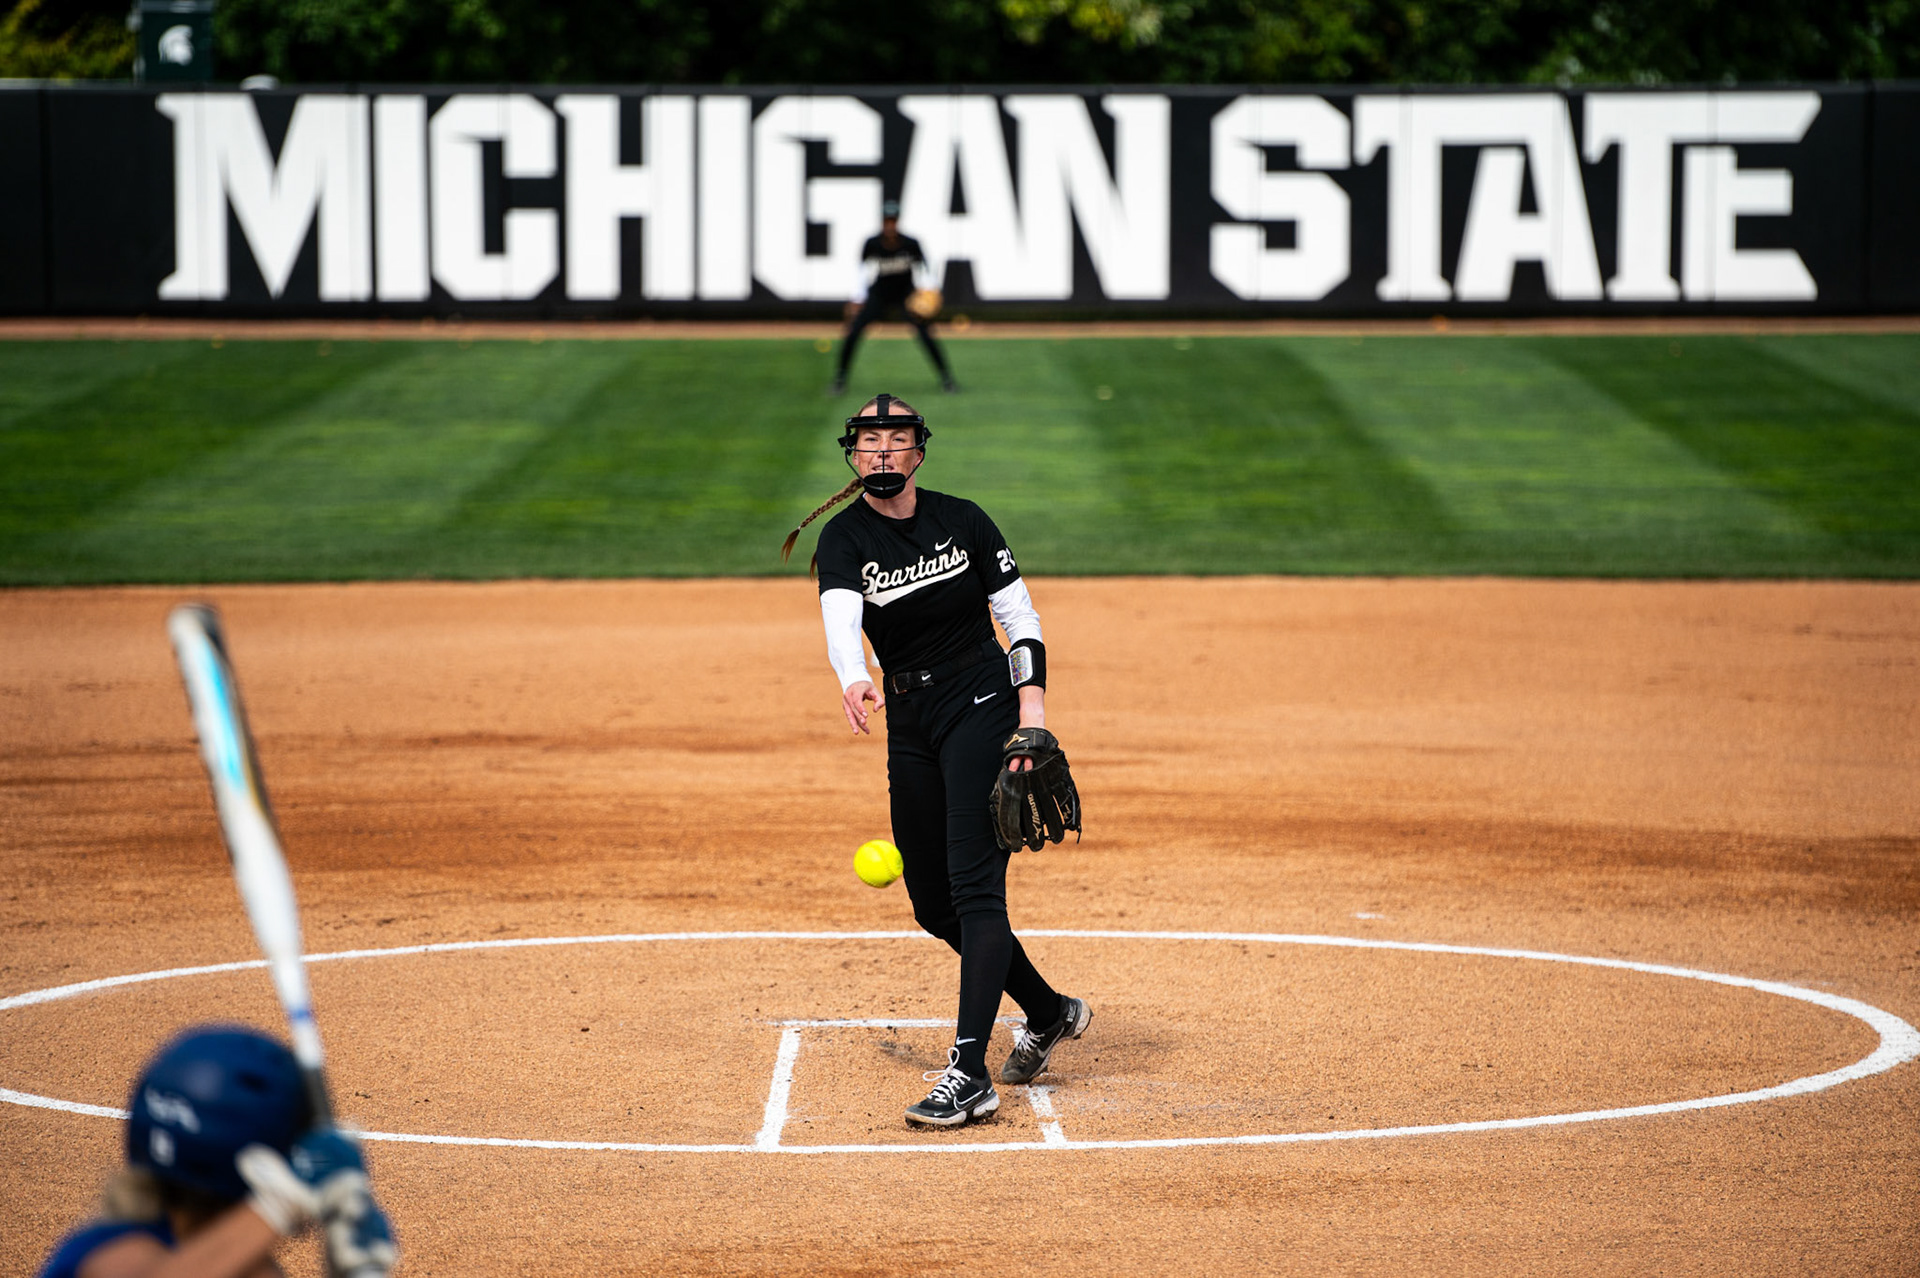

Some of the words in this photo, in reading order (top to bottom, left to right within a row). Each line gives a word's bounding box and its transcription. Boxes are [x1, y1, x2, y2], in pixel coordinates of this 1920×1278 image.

[157, 93, 1171, 302] MICHIGAN
[1209, 91, 1821, 302] STATE
[860, 546, 970, 597] Spartans
